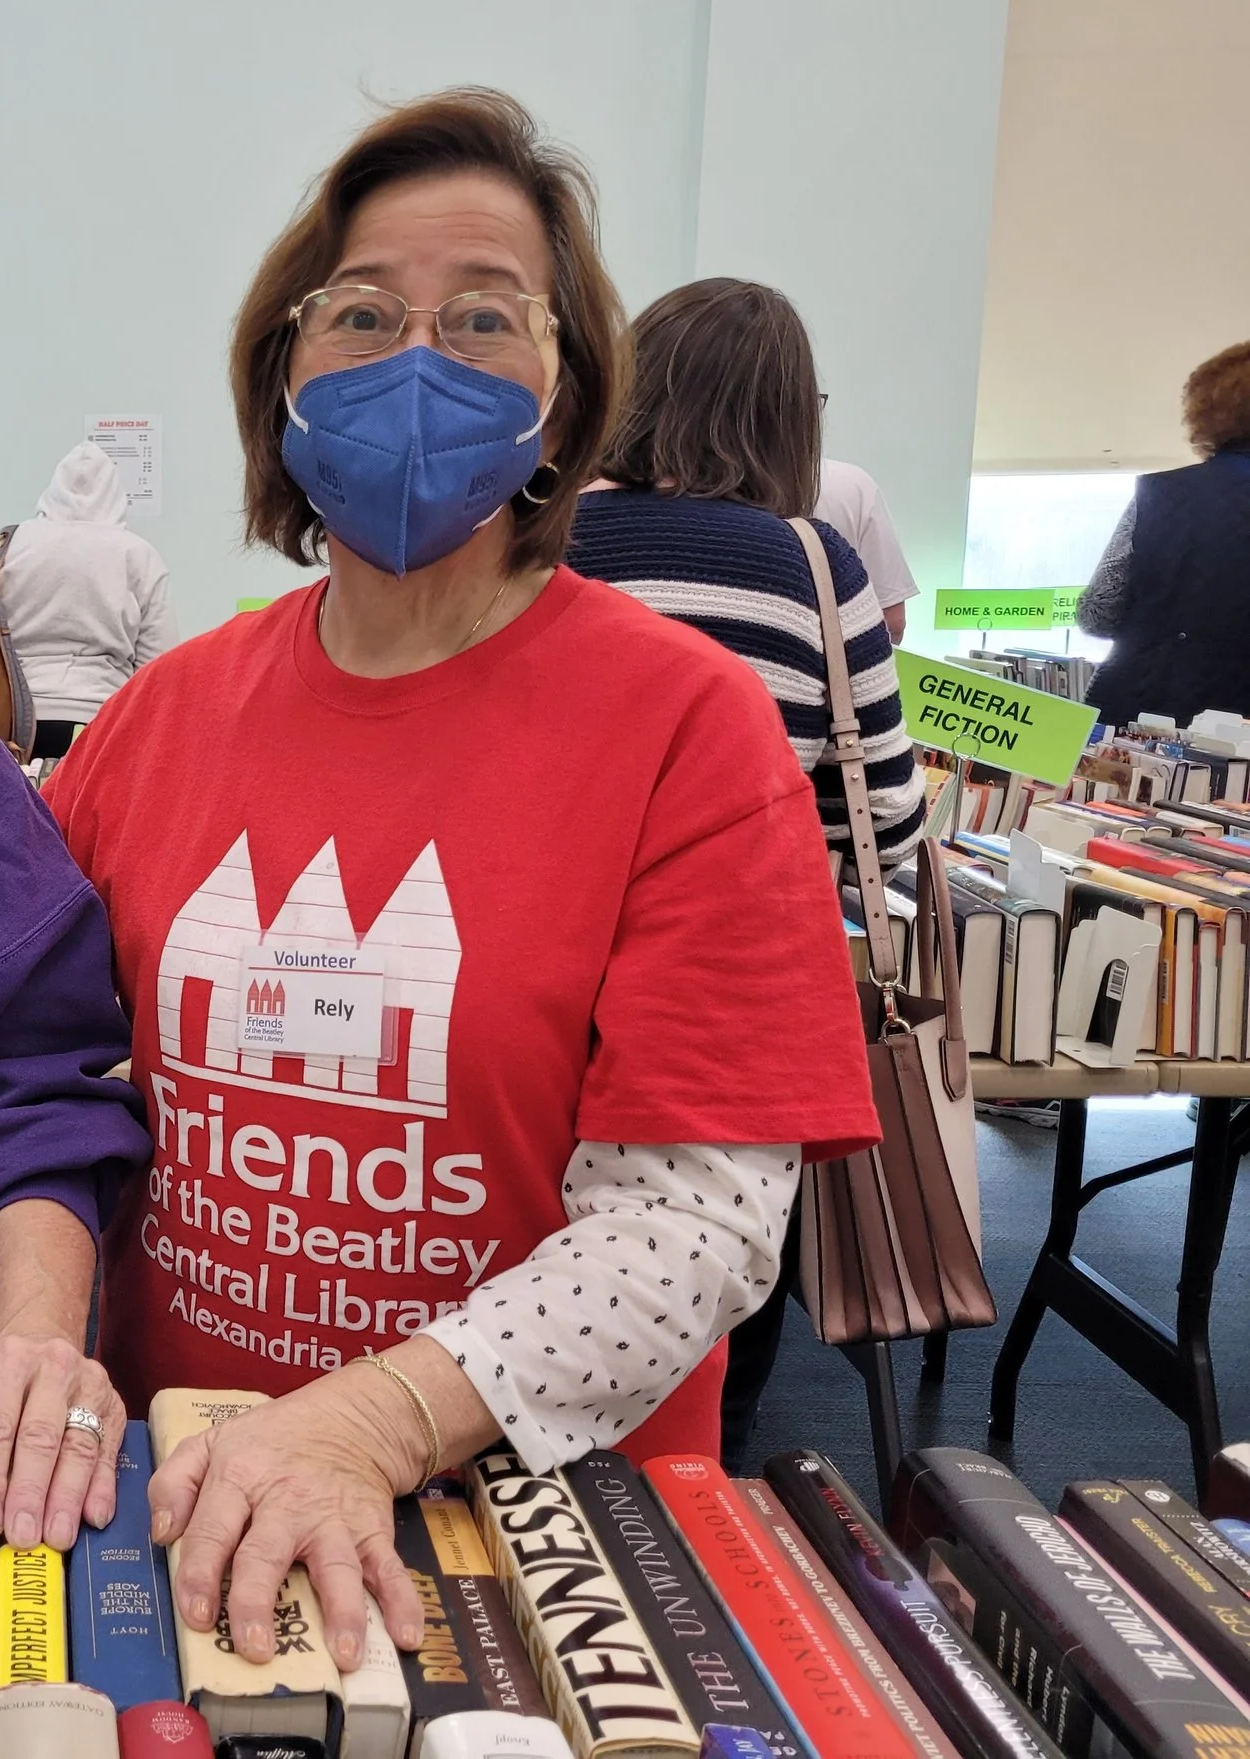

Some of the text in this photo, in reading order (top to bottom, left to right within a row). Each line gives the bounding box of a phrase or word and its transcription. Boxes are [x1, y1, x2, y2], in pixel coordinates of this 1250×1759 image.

[945, 607, 1045, 616] HOME & GARDEN
[1053, 598, 1078, 607] RELI
[919, 674, 1034, 726] GENERAL
[919, 705, 1019, 751] FICTION
[274, 950, 357, 969] Volunteer
[246, 1016, 283, 1029] Friends
[314, 998, 355, 1022] Rely
[244, 1034, 285, 1045] Central Library
[251, 1027, 262, 1035] the
[262, 1028, 284, 1037] Beatley
[149, 1070, 488, 1216] Friends
[149, 1164, 502, 1288] of the Beatley
[140, 1212, 470, 1337] Central Librar
[168, 1287, 343, 1372] Alexandria
[669, 1463, 705, 1471] VIKING
[748, 1488, 773, 1515] PRAEGER
[435, 1508, 469, 1569] Jennet Conant
[850, 1520, 884, 1557] KEVIN
[1014, 1515, 1093, 1575] JERICHO
[1131, 1517, 1175, 1555] TRAISTER
[107, 1582, 141, 1591] AGES
[1064, 1570, 1113, 1594] OF
[1171, 1554, 1218, 1593] REBECCA
[98, 1591, 151, 1599] MIDDLE
[100, 1606, 153, 1615] EUROPE
[102, 1598, 149, 1607] IN THE
[474, 1448, 683, 1740] TENNESSE
[595, 1478, 750, 1713] THE UNWINDING
[688, 1490, 852, 1718] STONES SCHOOLS
[10, 1551, 48, 1684] MPERFECT JUSTICE
[109, 1626, 149, 1635] HOYT
[773, 1525, 923, 1733] POLITICS FROM BREZHNEV TO GORBACHEV
[901, 1599, 971, 1668] PURSUIT
[1086, 1593, 1165, 1648] WALLS
[1208, 1604, 1250, 1636] CRY
[415, 1624, 469, 1683] BONE
[458, 1579, 521, 1706] EAST PALACE
[1027, 1646, 1038, 1709] Richard
[1133, 1648, 1196, 1681] THE
[49, 1700, 105, 1717] GATEWAY
[1042, 1665, 1054, 1722] Hubert
[150, 1716, 190, 1724] RANDOM
[1058, 1686, 1071, 1744] Lyndon
[256, 1749, 306, 1759] Mifflin
[494, 1733, 531, 1747] Knopf
